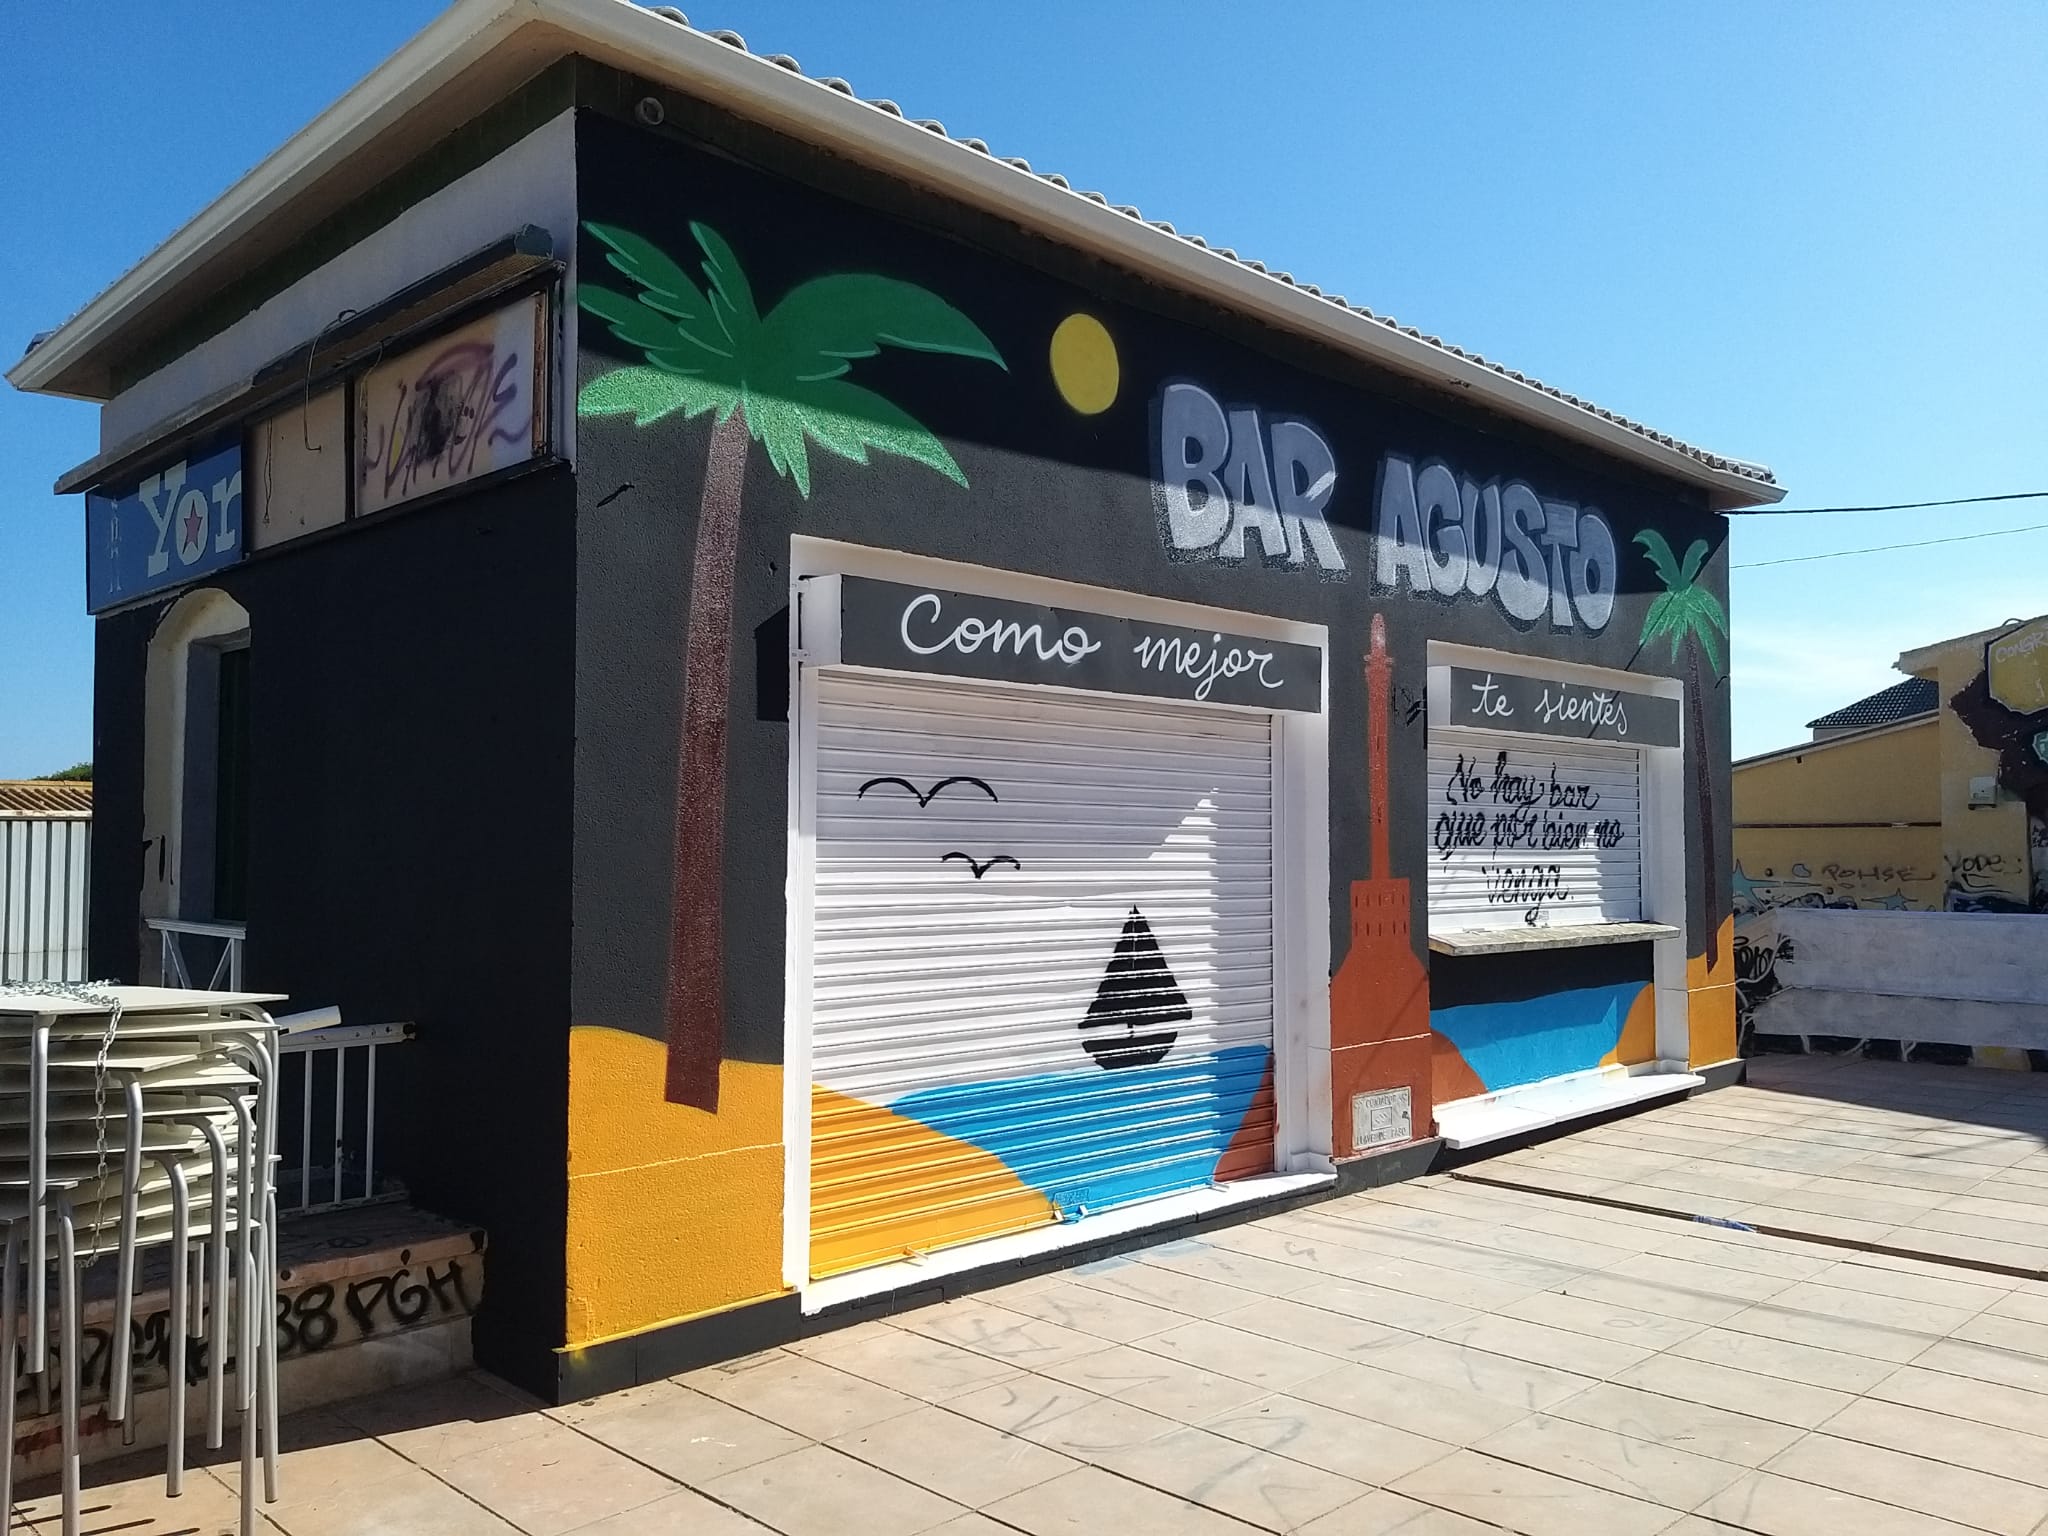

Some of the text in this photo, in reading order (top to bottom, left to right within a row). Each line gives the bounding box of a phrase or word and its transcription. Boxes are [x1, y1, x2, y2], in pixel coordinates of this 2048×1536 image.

[1160, 382, 1618, 631] BAR AGUSTO
[900, 593, 1285, 701] Como mejor
[1471, 673, 1628, 735] te sientes
[1446, 751, 1601, 826] No hay bar
[1594, 818, 1625, 849] no
